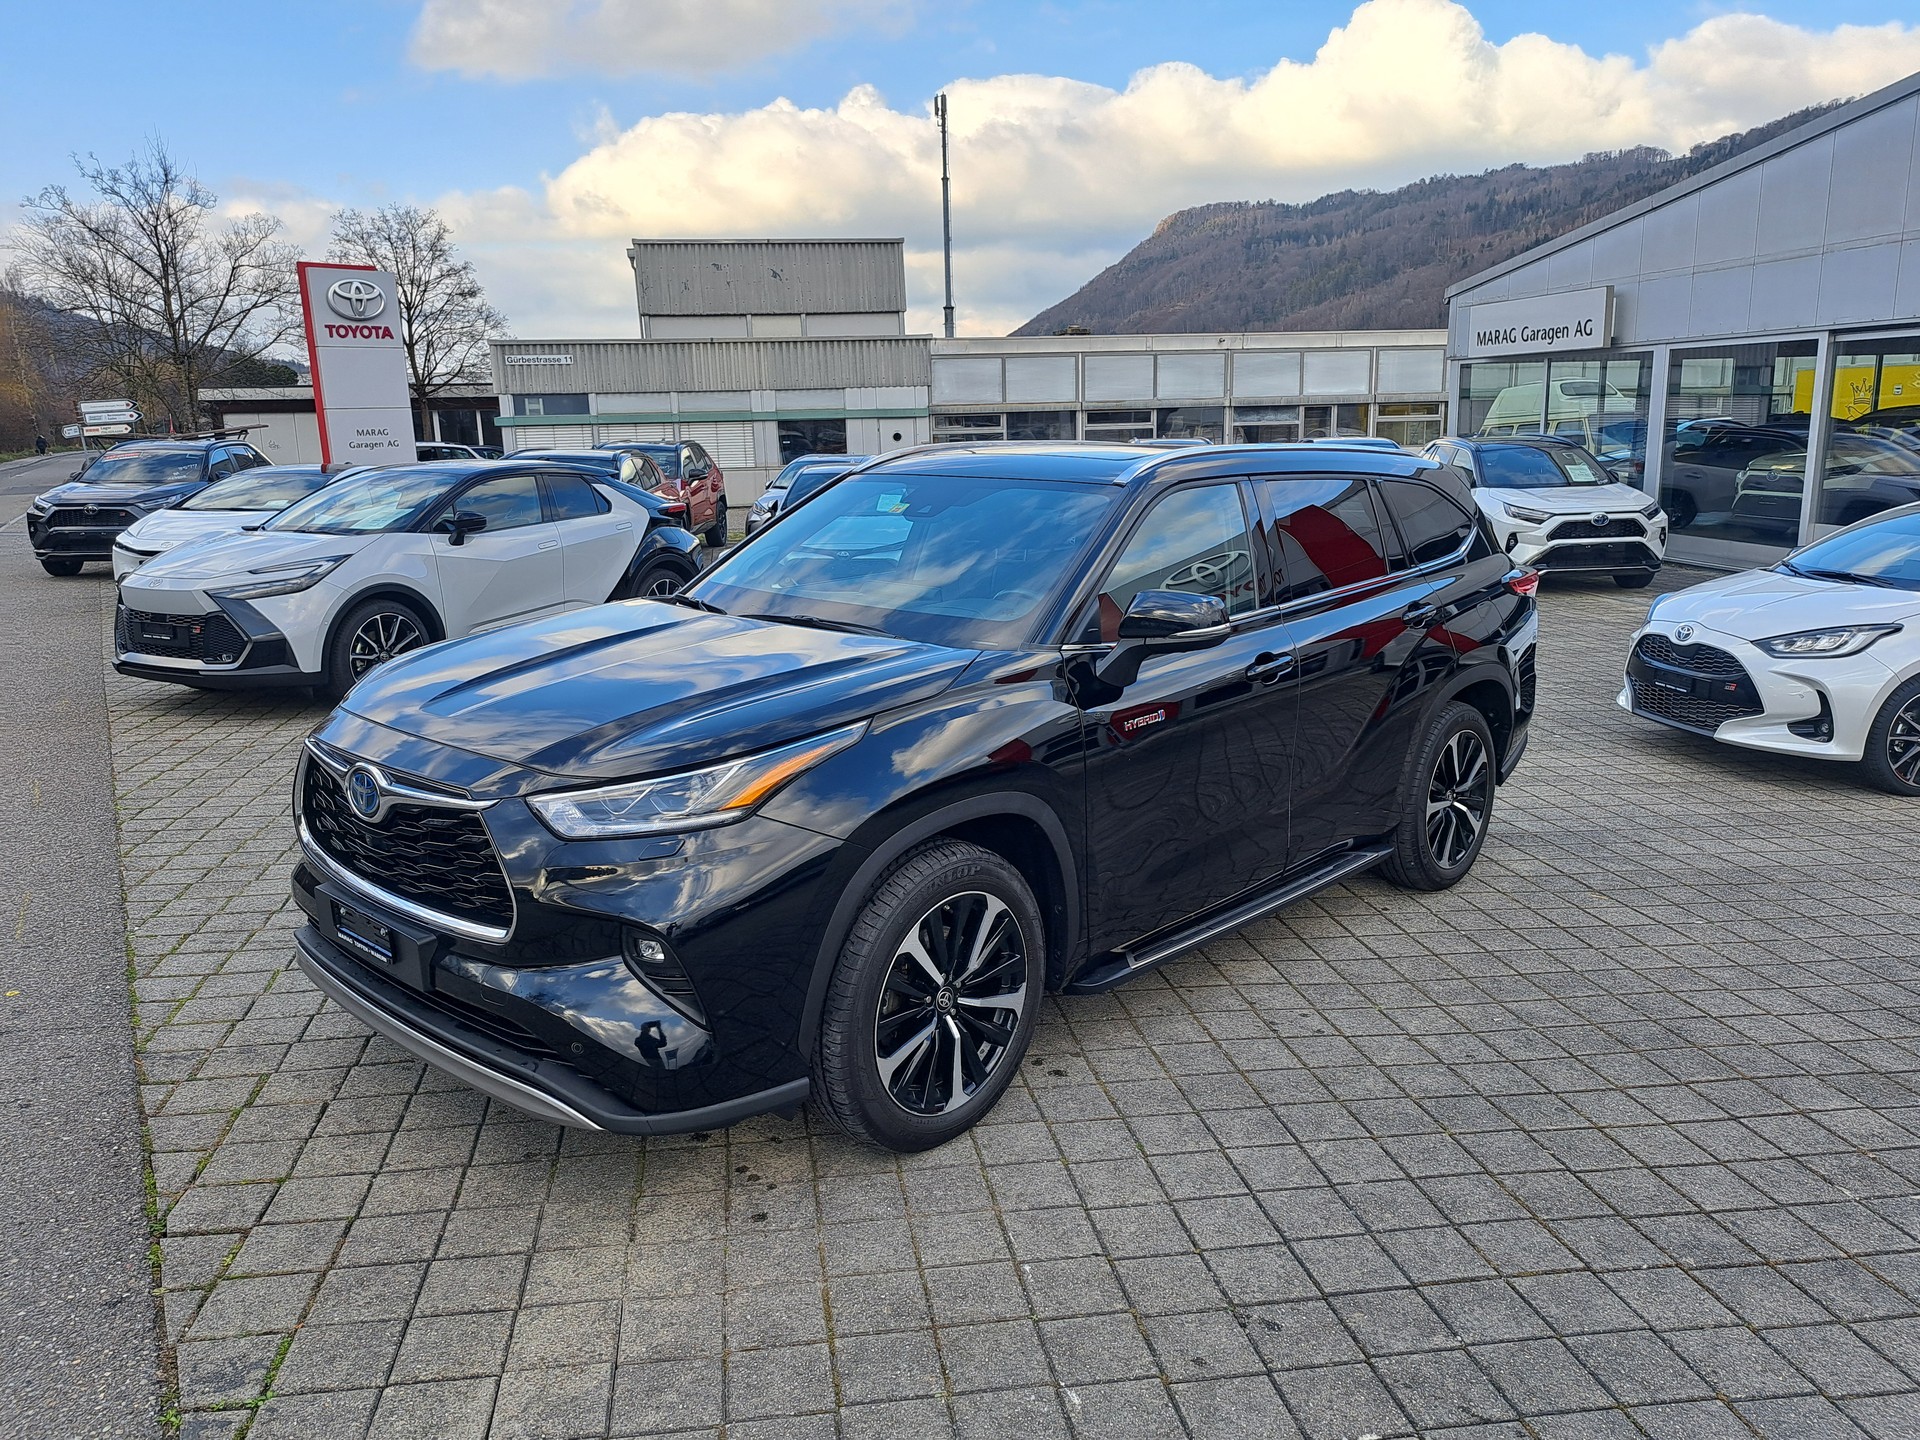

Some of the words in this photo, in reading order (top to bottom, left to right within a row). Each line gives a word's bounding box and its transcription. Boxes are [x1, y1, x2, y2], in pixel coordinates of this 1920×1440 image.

[324, 324, 394, 340] TOYOTA
[1476, 327, 1517, 347] MARAG
[1521, 325, 1569, 346] Garagen
[1573, 318, 1593, 338] AG
[506, 356, 562, 364] Gürbestrasse
[356, 428, 389, 437] MARAG
[348, 441, 384, 450] Garagen
[387, 440, 400, 448] AG
[1124, 712, 1159, 731] HYBRID
